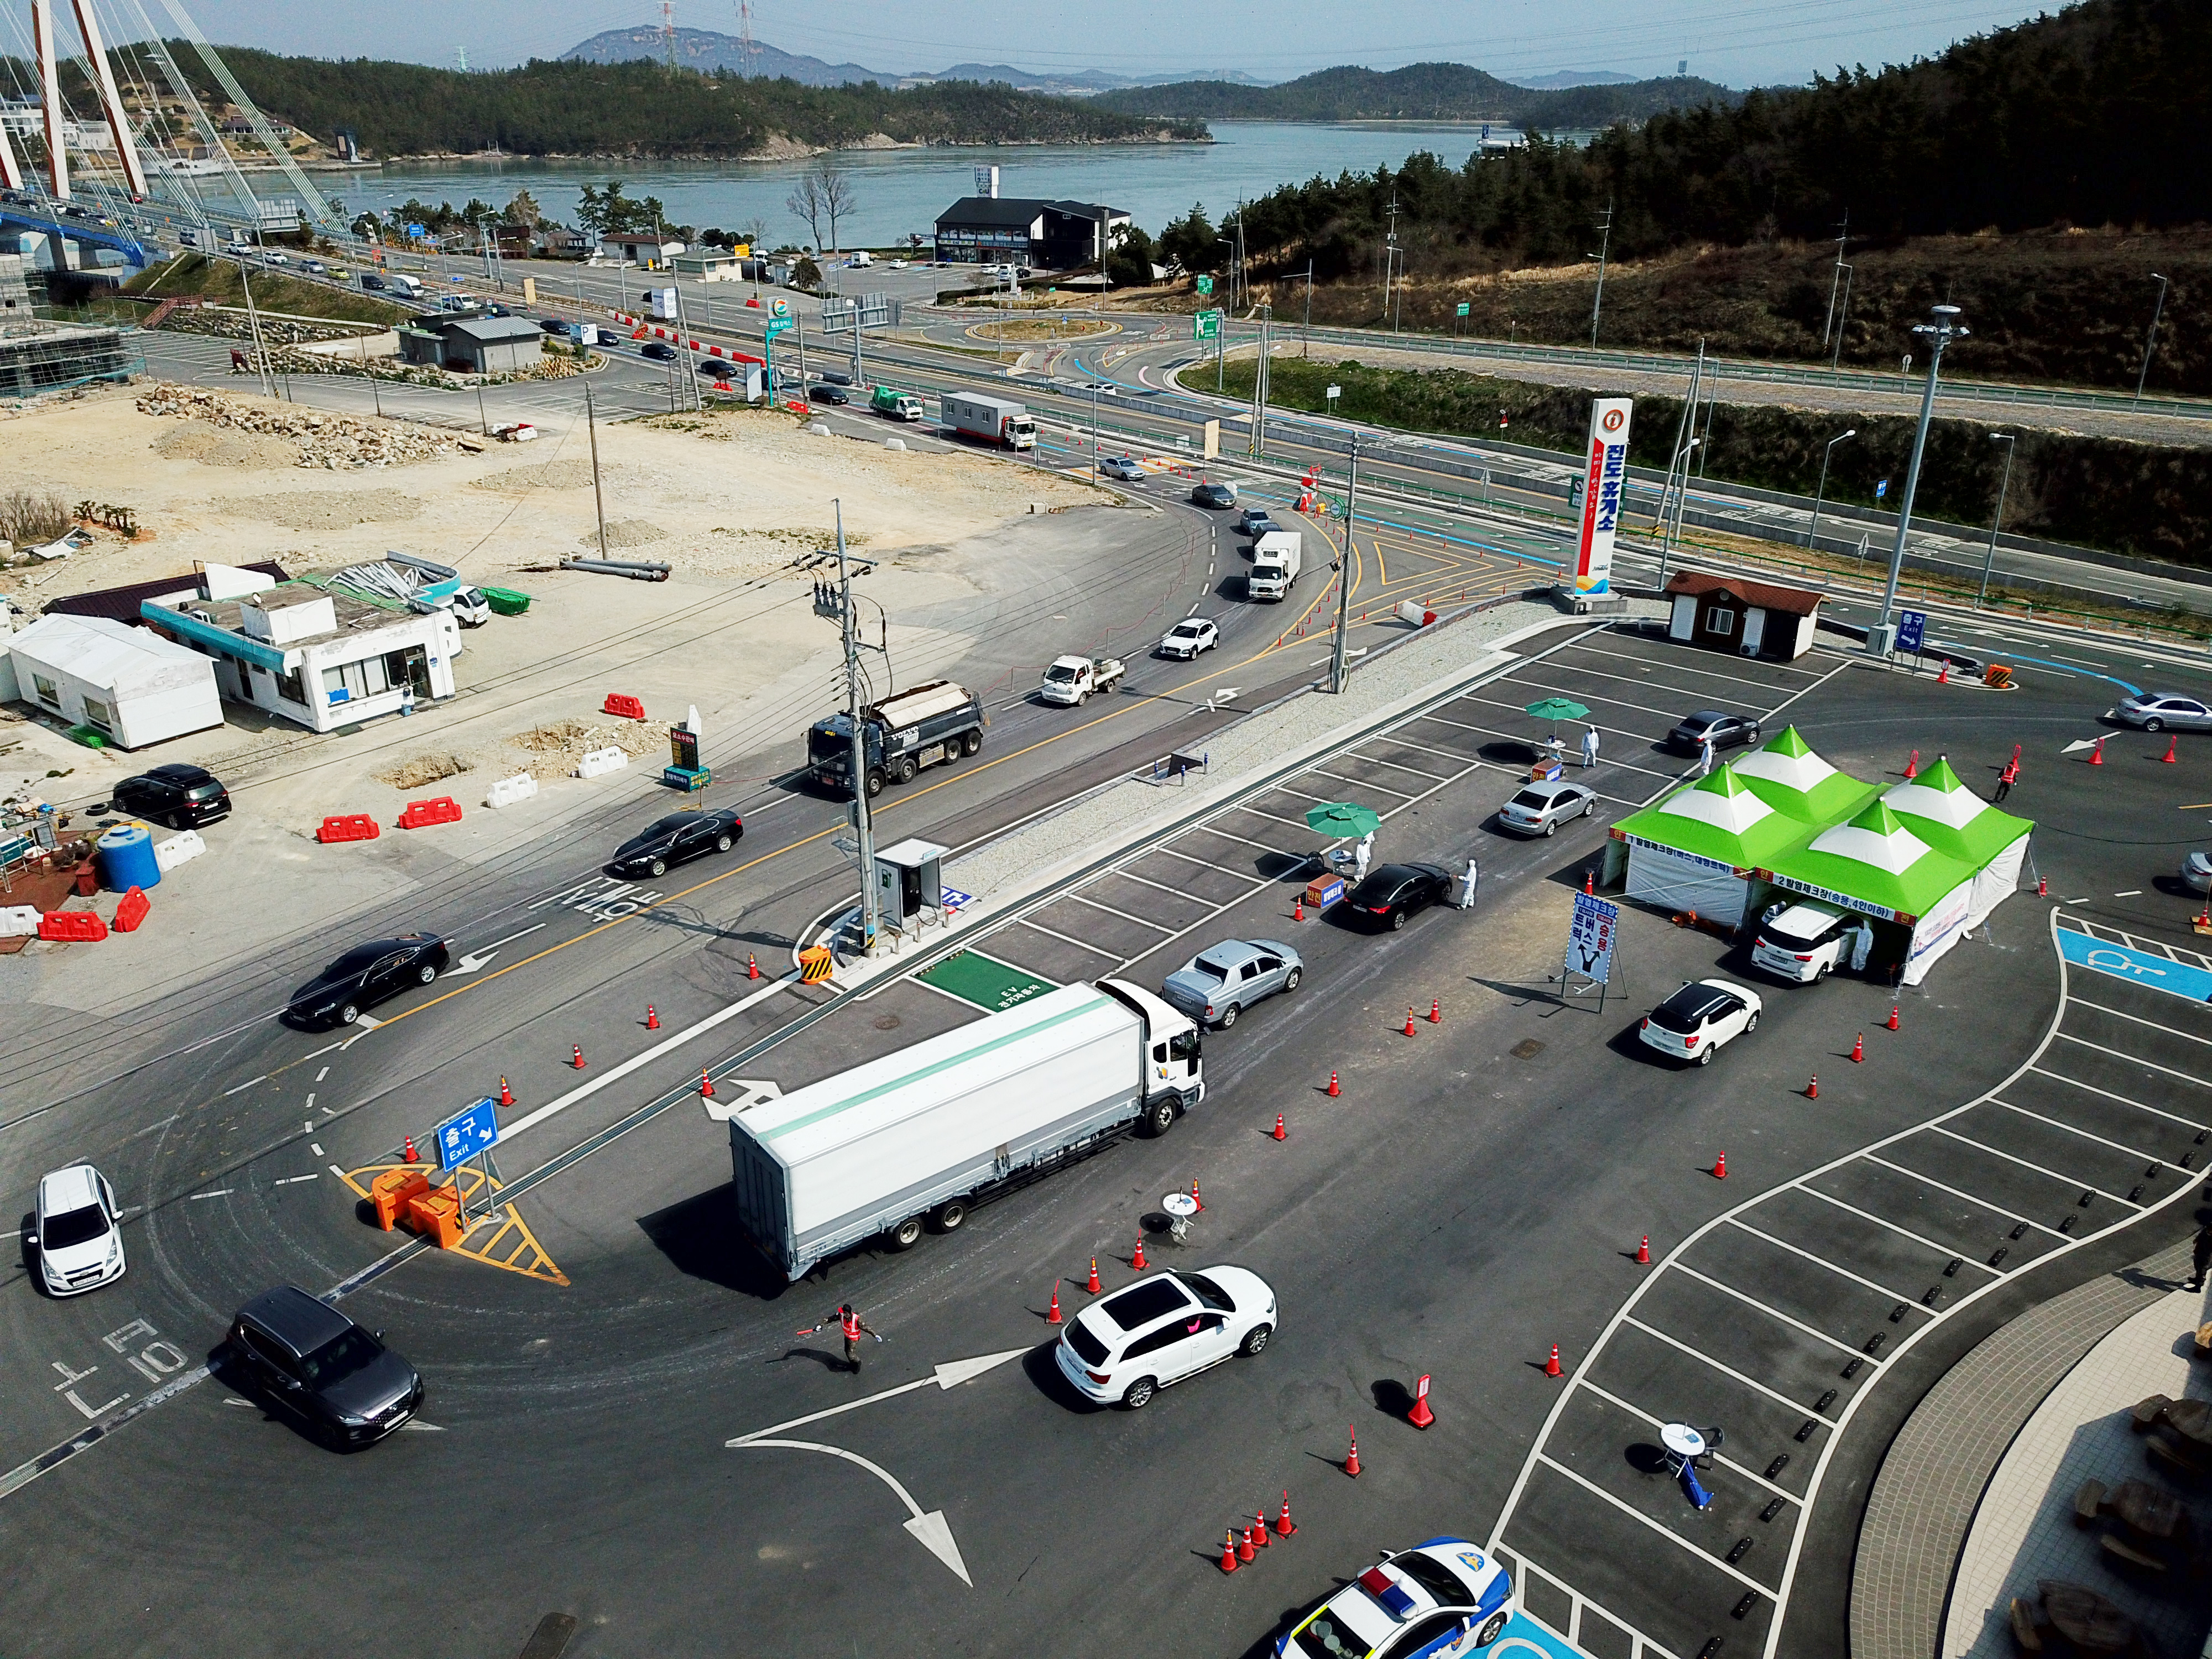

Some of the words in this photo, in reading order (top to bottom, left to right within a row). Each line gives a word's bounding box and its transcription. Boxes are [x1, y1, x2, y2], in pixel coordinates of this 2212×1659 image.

[582, 326, 589, 338] P
[1903, 613, 1923, 626] 출구
[1903, 625, 1918, 633] Exit
[1760, 869, 1769, 880] 안
[1778, 876, 1785, 885] 2
[1307, 889, 1321, 904] 안전
[1577, 894, 1615, 916] 발열체크장
[1573, 913, 1584, 942] 트럭
[1582, 917, 1595, 945] 버스
[1597, 924, 1609, 952] 승용
[998, 984, 1041, 1008] 전기자동차
[445, 1117, 476, 1148] 출구
[449, 1143, 469, 1161] Exit
